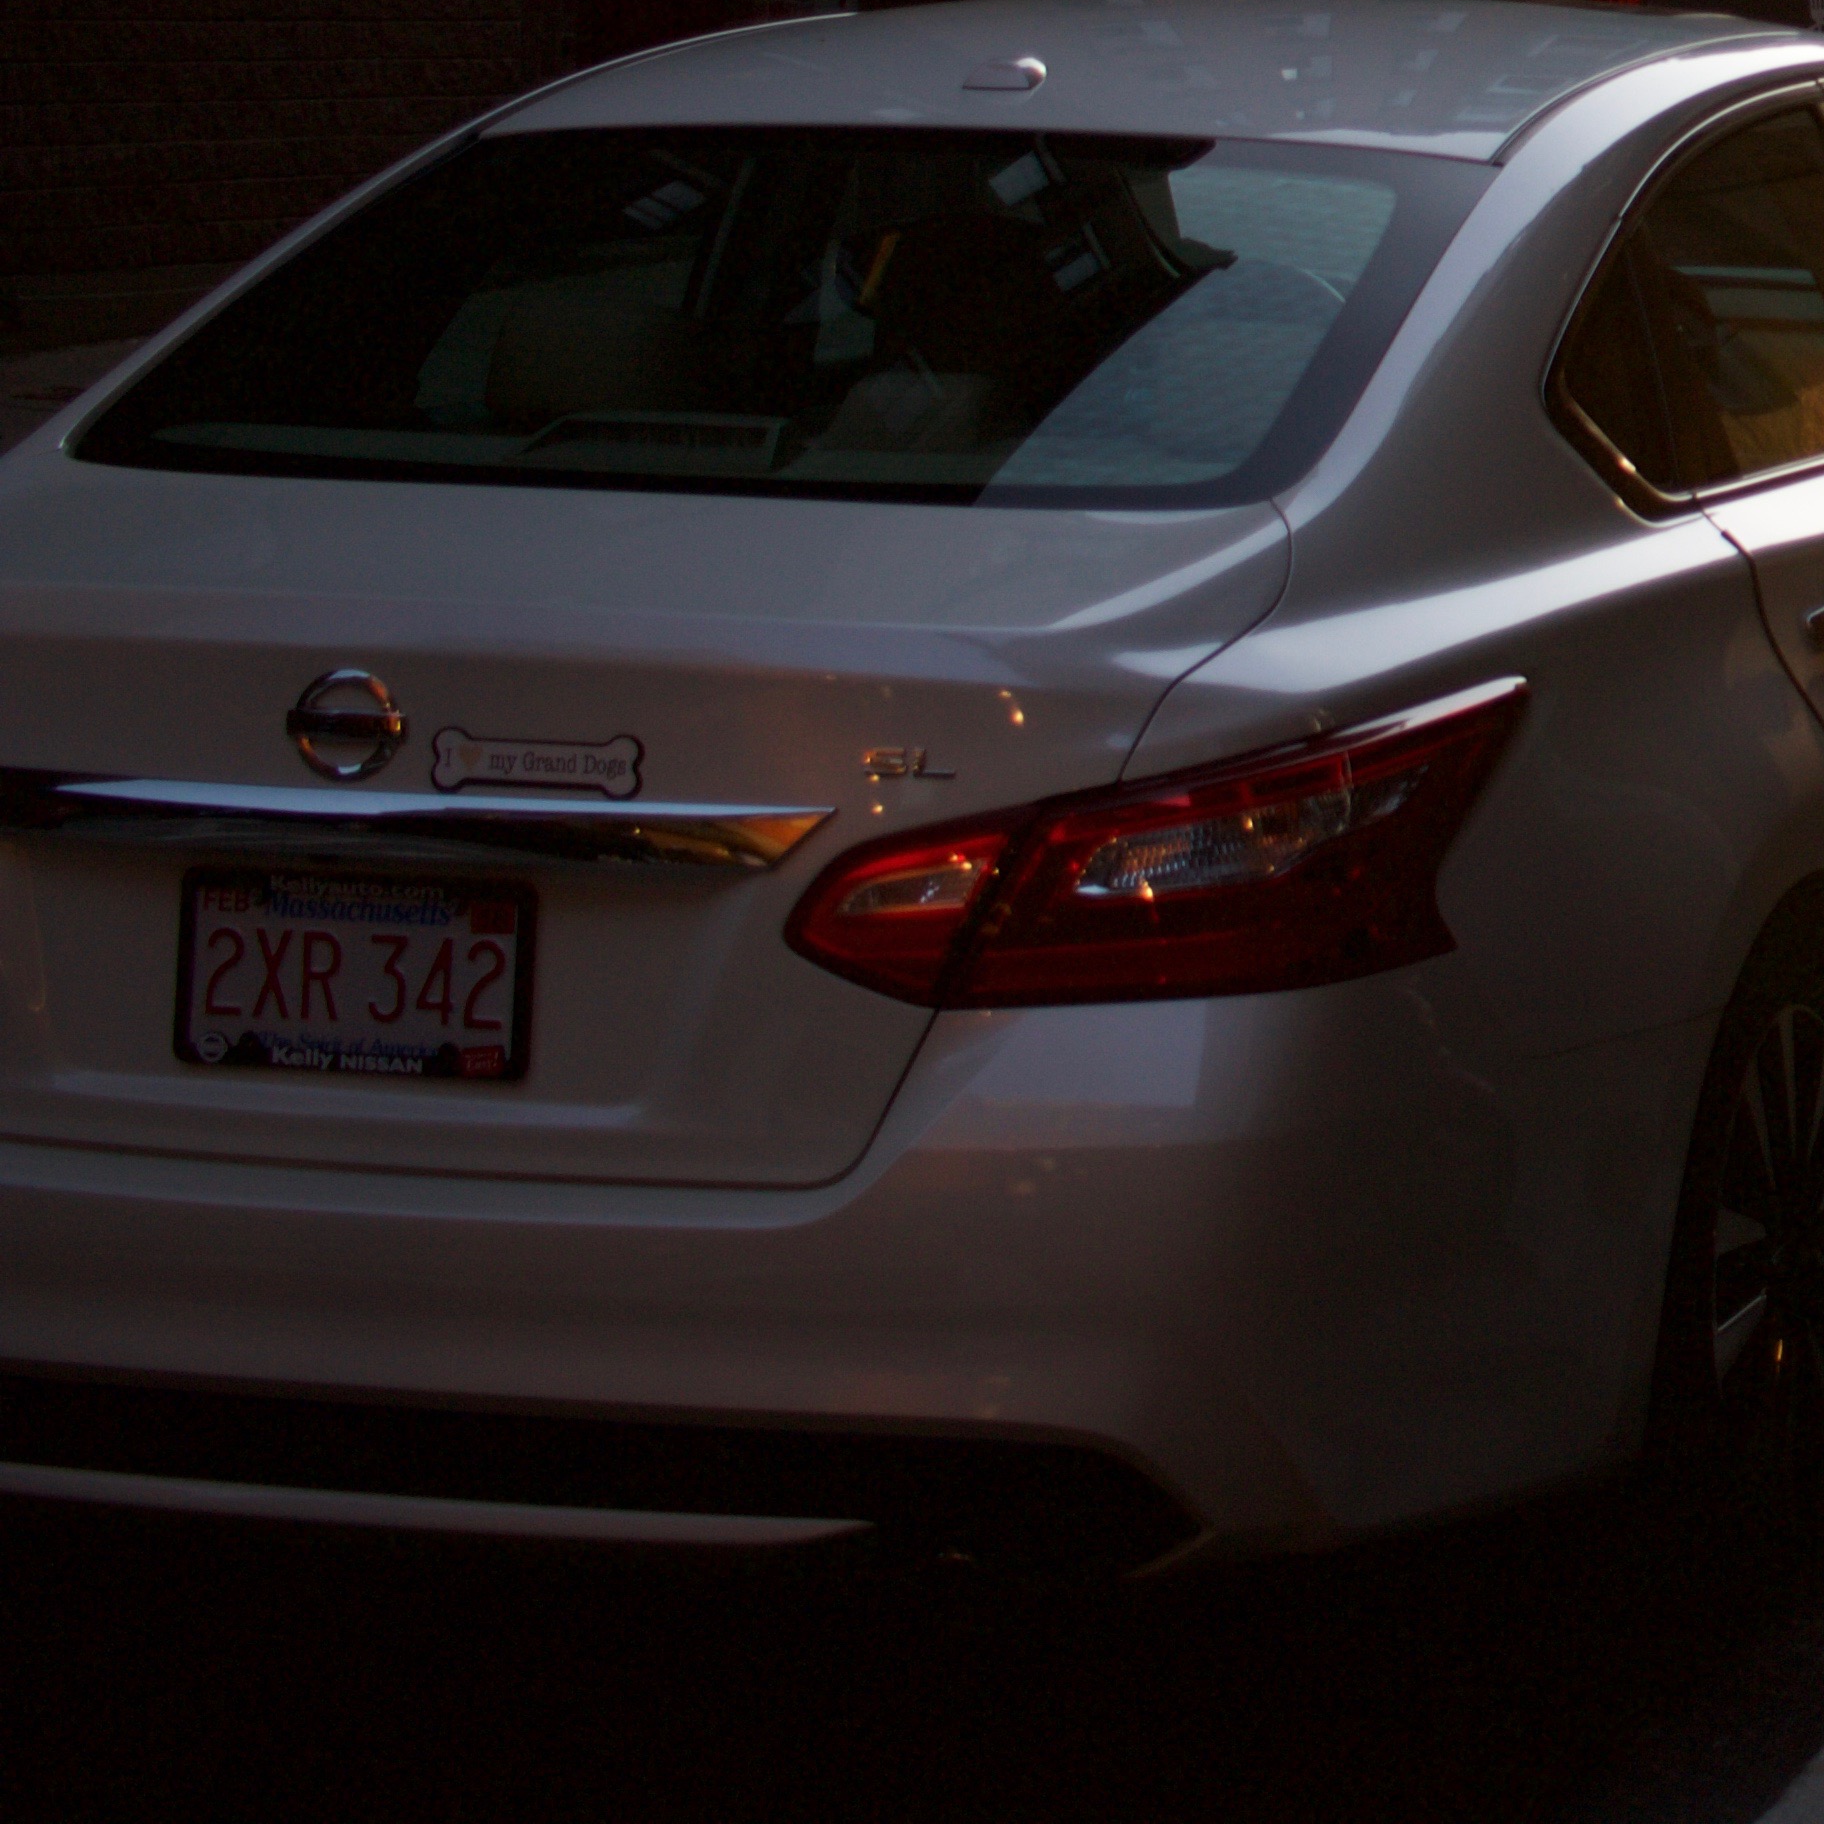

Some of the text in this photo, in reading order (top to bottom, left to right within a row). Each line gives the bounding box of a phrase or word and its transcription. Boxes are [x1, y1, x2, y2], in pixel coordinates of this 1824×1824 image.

[443, 747, 627, 779] I my Grand Dogs
[203, 888, 250, 913] FEB
[264, 894, 453, 927] Massachusetts
[205, 927, 507, 1031] 2XR 342
[271, 1045, 425, 1075] Kelly NISSAN
